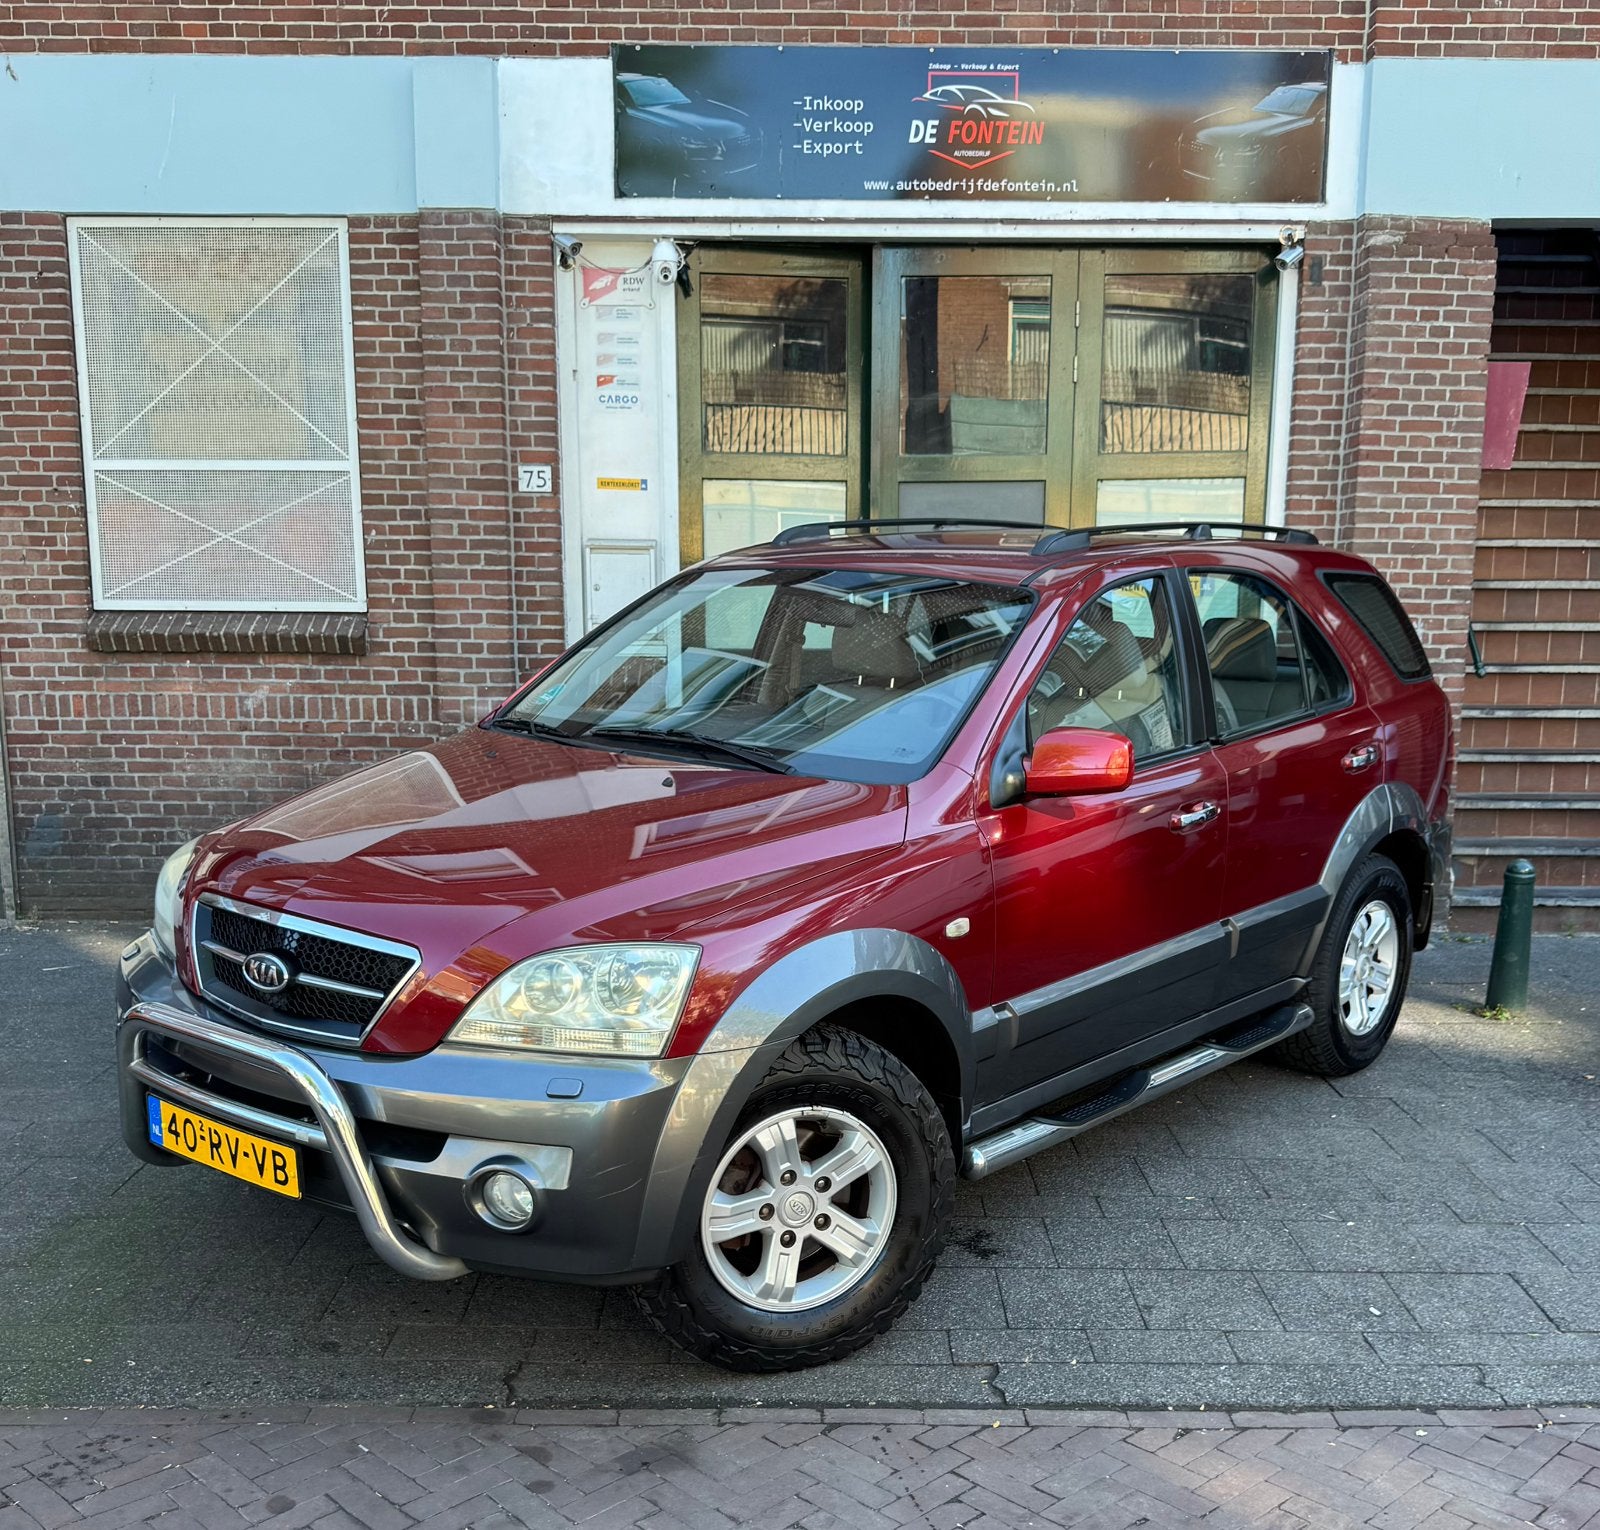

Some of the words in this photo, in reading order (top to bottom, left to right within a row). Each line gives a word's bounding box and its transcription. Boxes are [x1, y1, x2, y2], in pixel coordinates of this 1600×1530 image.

[928, 62, 951, 70] Inkoop
[793, 95, 864, 114] -Inkoop
[793, 117, 874, 136] -Verkoop
[908, 119, 940, 143] DE
[947, 120, 1045, 144] FONTEIN
[793, 140, 863, 158] -Export
[863, 178, 1079, 194] www.autobedrijfdefontein.nl
[622, 277, 645, 285] RDW
[598, 395, 639, 404] CARGO
[523, 470, 547, 489] 75
[249, 957, 279, 986] KIA
[152, 1123, 162, 1137] NL
